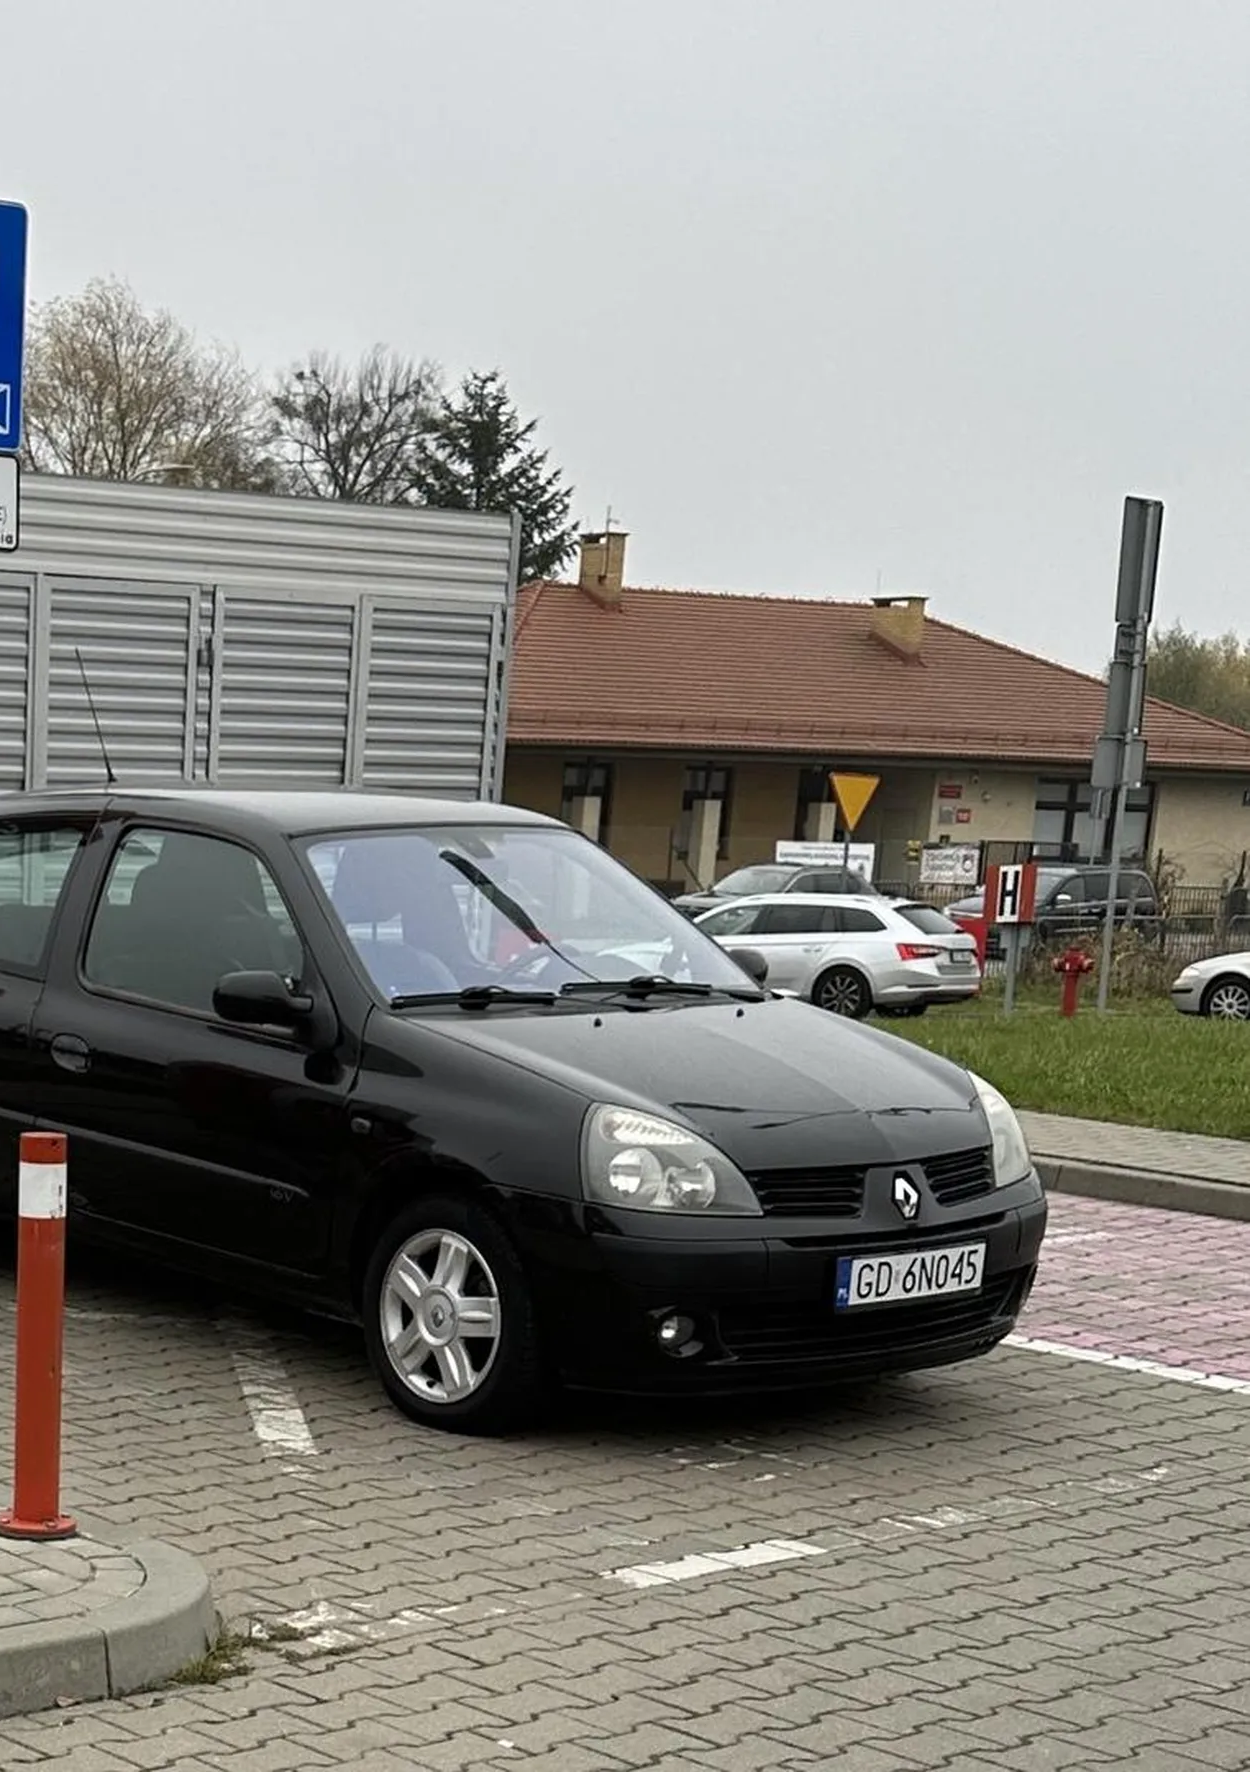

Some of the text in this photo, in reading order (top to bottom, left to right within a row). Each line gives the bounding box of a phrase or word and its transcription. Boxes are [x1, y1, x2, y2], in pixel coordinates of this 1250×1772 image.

[999, 870, 1020, 917] H
[856, 1249, 979, 1299] GD 6N045
